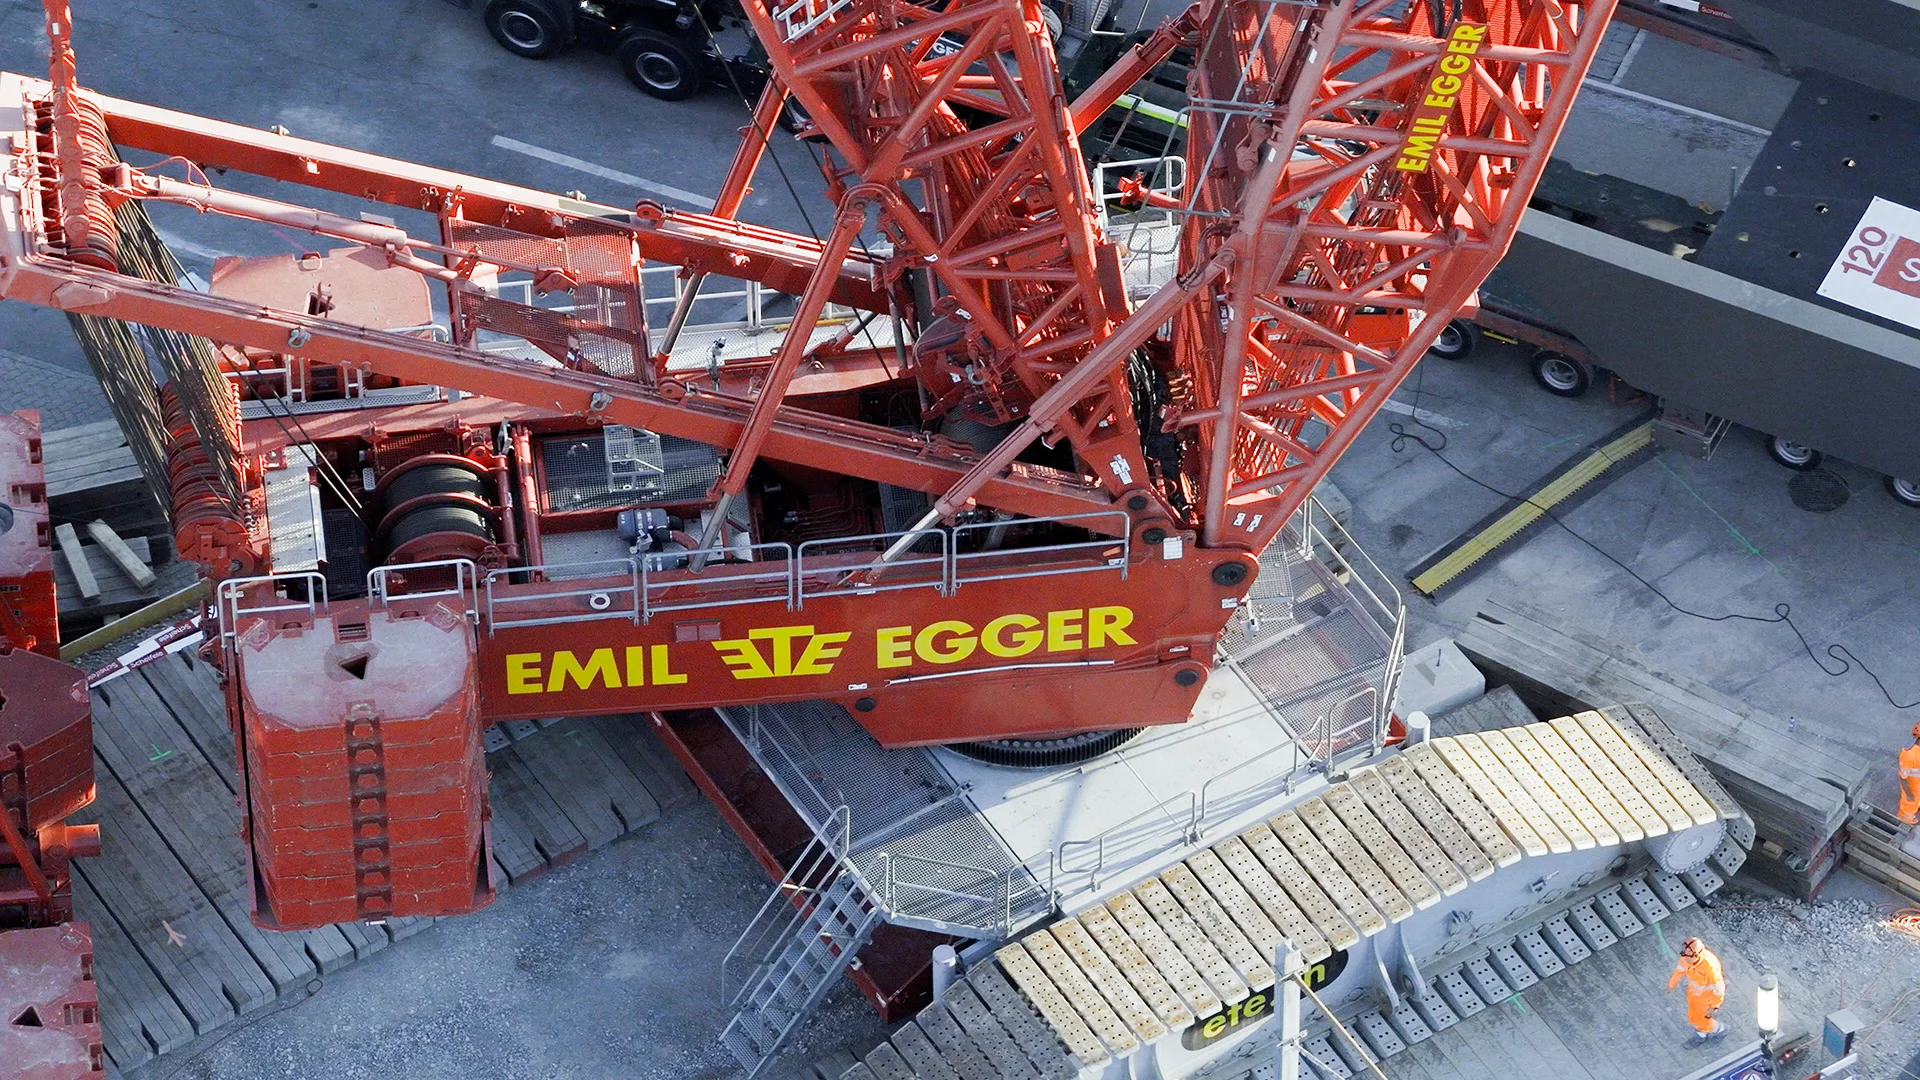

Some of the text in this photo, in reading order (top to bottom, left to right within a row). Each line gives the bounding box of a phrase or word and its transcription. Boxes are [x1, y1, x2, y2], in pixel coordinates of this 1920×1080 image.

[1396, 24, 1487, 172] EMIL EGGER
[1840, 226, 1888, 276] 120
[505, 644, 688, 695] EMIL
[876, 605, 1138, 669] EGGER
